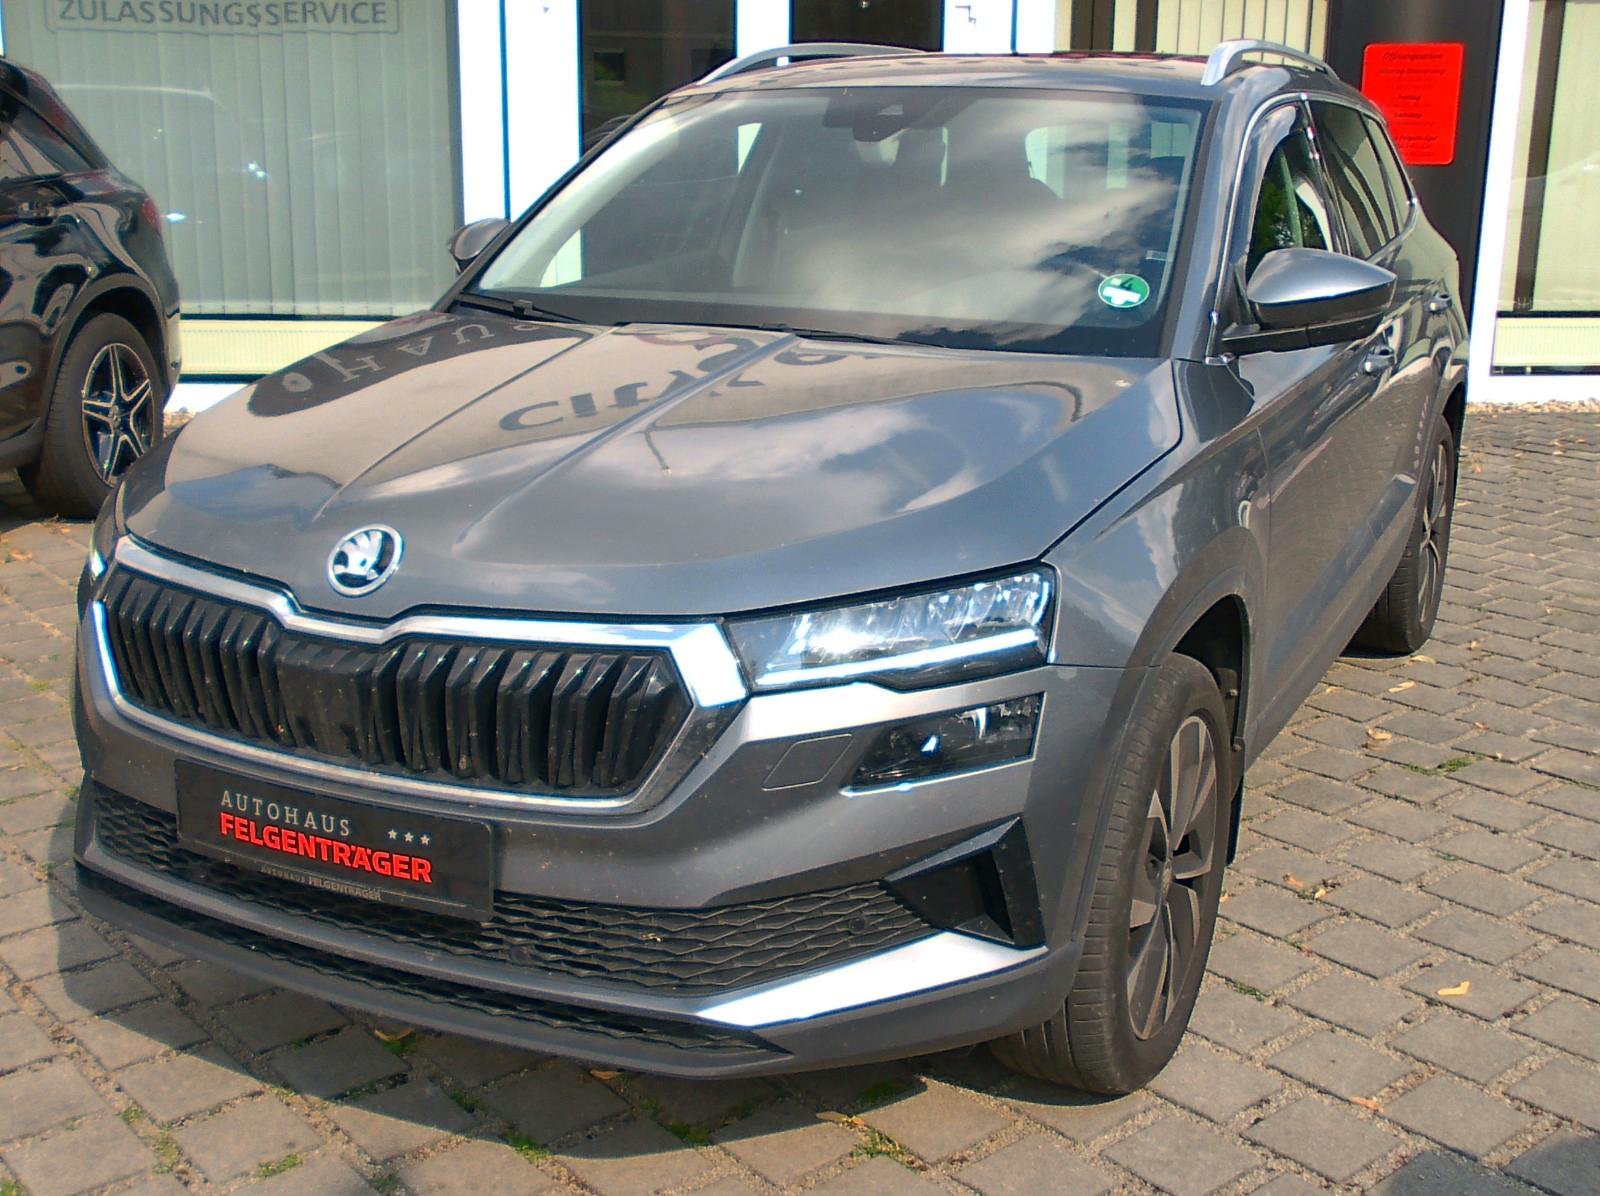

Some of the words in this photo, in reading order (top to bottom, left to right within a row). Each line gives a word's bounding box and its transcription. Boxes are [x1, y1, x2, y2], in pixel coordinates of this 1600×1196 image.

[58, 0, 388, 27] ZULASSUNGSSERVICE
[220, 790, 352, 837] AUTOHAUS
[218, 811, 434, 884] FELGENTRÄGER
